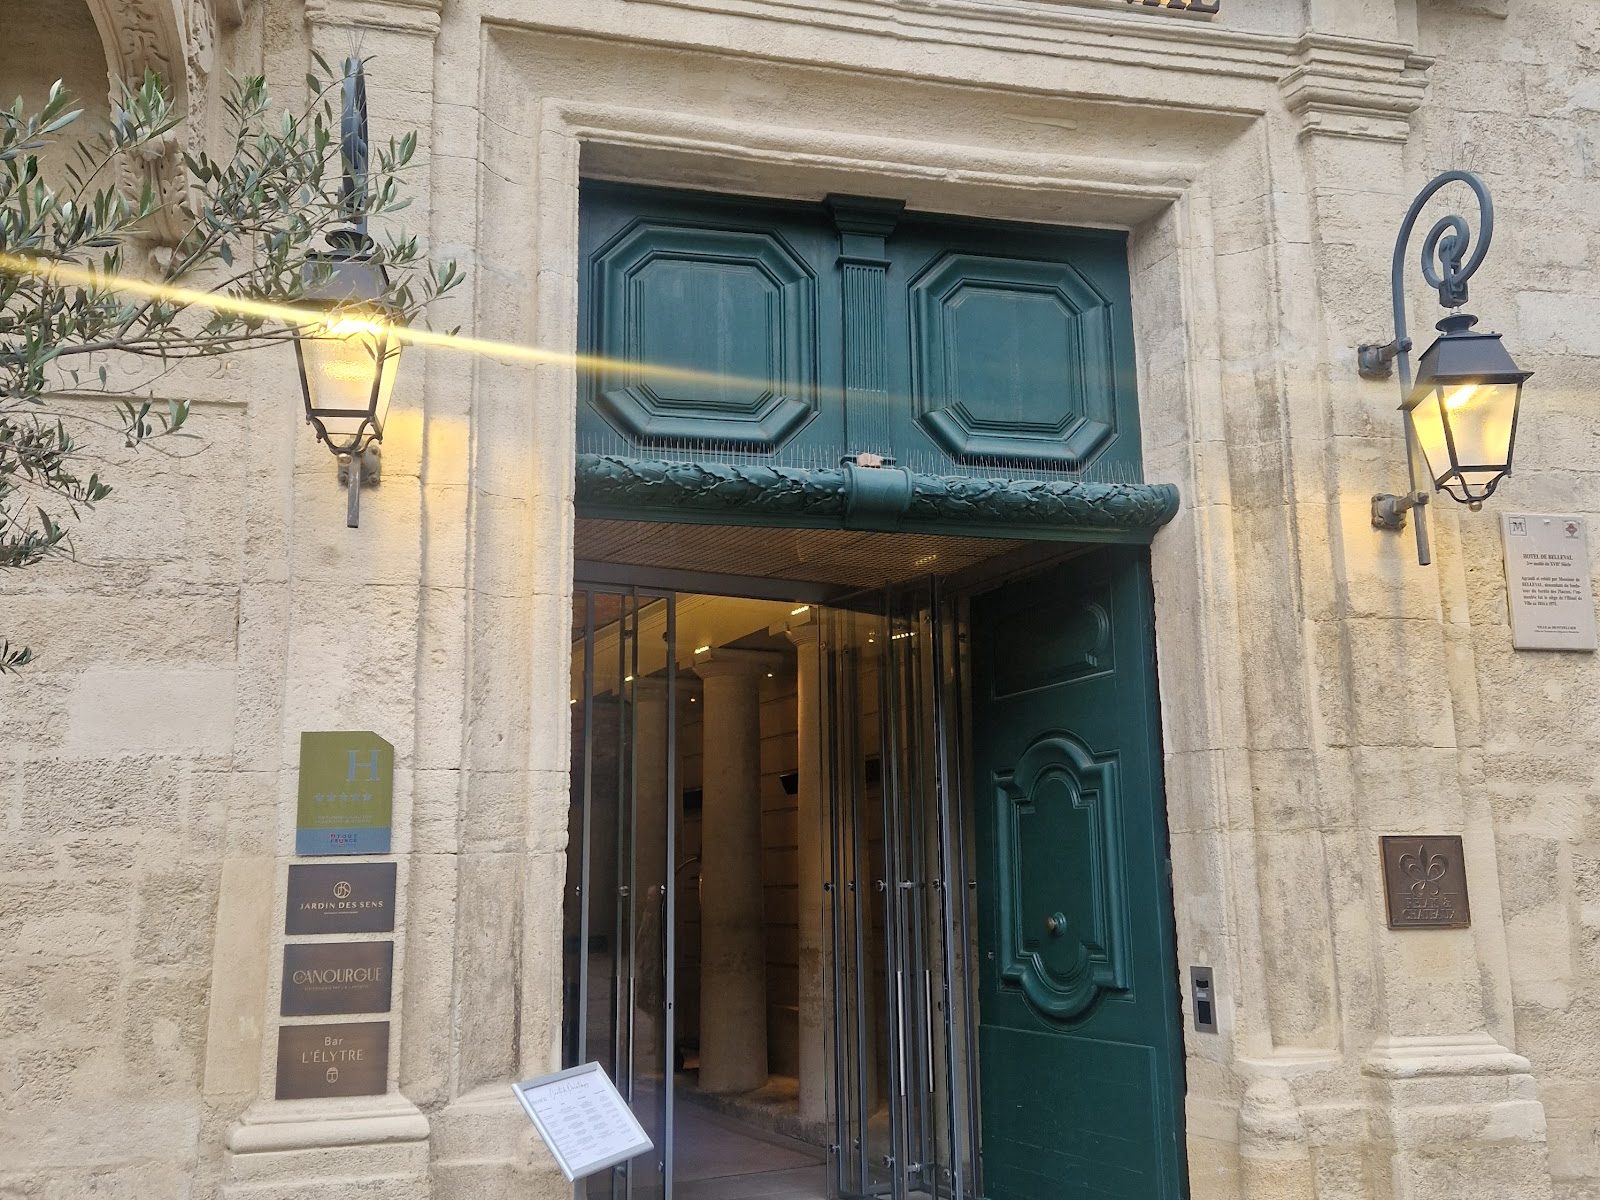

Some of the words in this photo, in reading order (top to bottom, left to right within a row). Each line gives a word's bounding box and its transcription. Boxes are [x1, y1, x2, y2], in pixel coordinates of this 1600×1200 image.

[345, 749, 382, 782] H
[300, 901, 335, 910] JARDIN
[338, 901, 357, 909] DES
[359, 900, 384, 908] SENS
[324, 1036, 343, 1046] Bar
[302, 1049, 364, 1064] L'ÉLYTRE
